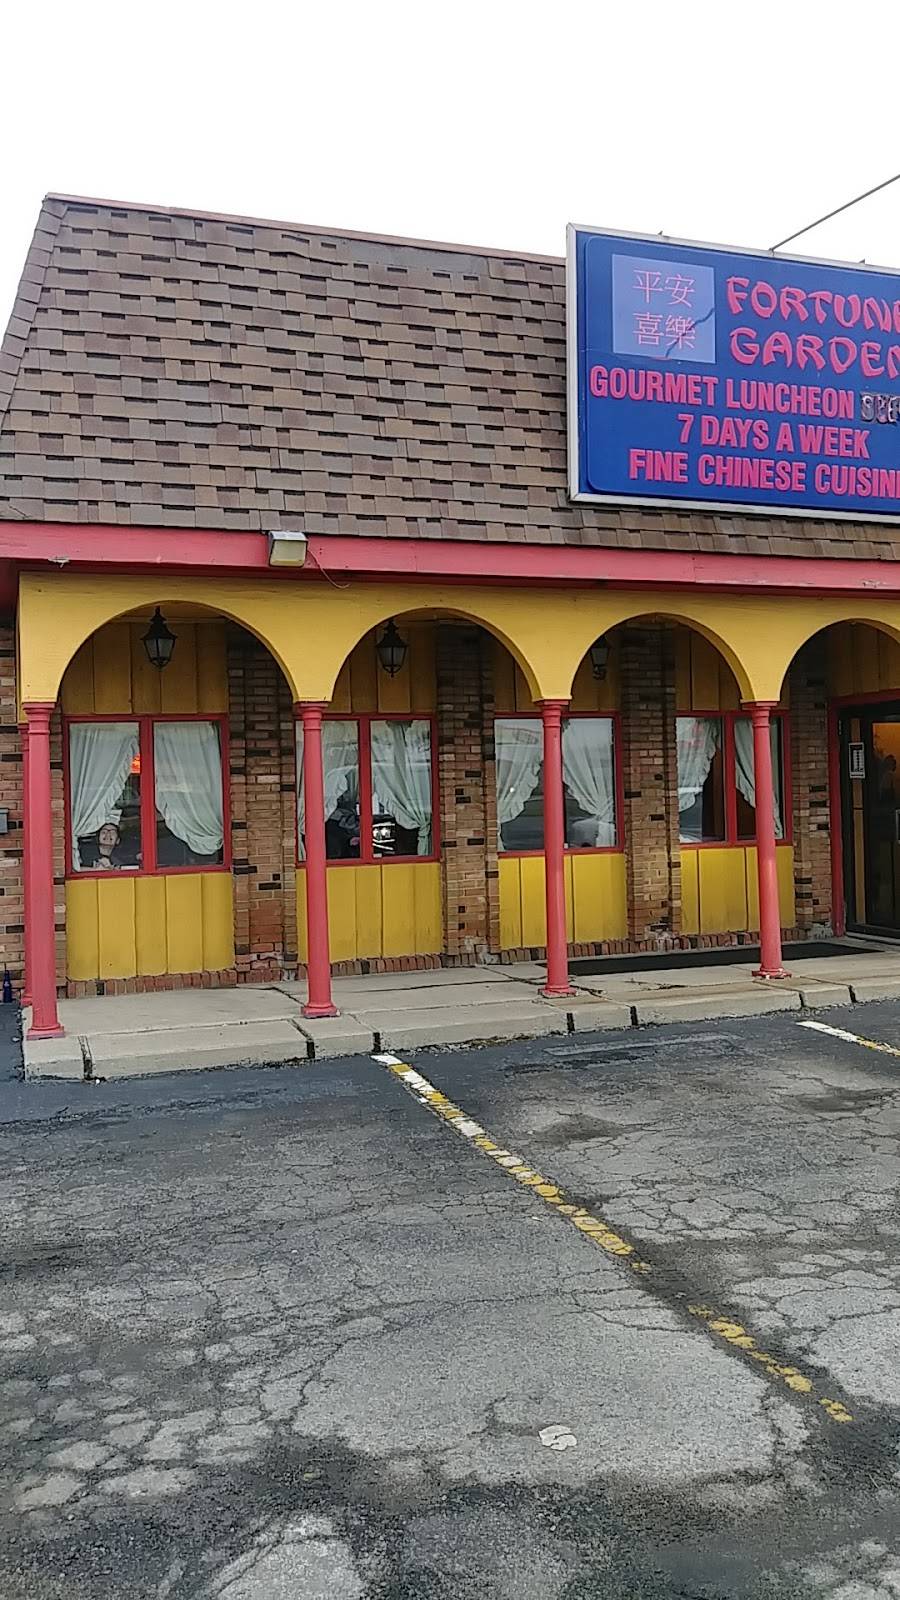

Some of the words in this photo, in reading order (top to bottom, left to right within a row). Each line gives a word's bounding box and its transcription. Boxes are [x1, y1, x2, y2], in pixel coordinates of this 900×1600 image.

[633, 269, 695, 308] 平安
[633, 312, 695, 349] 喜樂
[589, 365, 718, 406] GOURMET
[726, 378, 854, 419] LUNCHEON
[678, 413, 694, 443] 7
[701, 415, 769, 448] DAYS
[776, 423, 795, 451] A
[798, 424, 870, 459] WEEK
[628, 449, 688, 482] FINE
[698, 455, 806, 491] CHINESE
